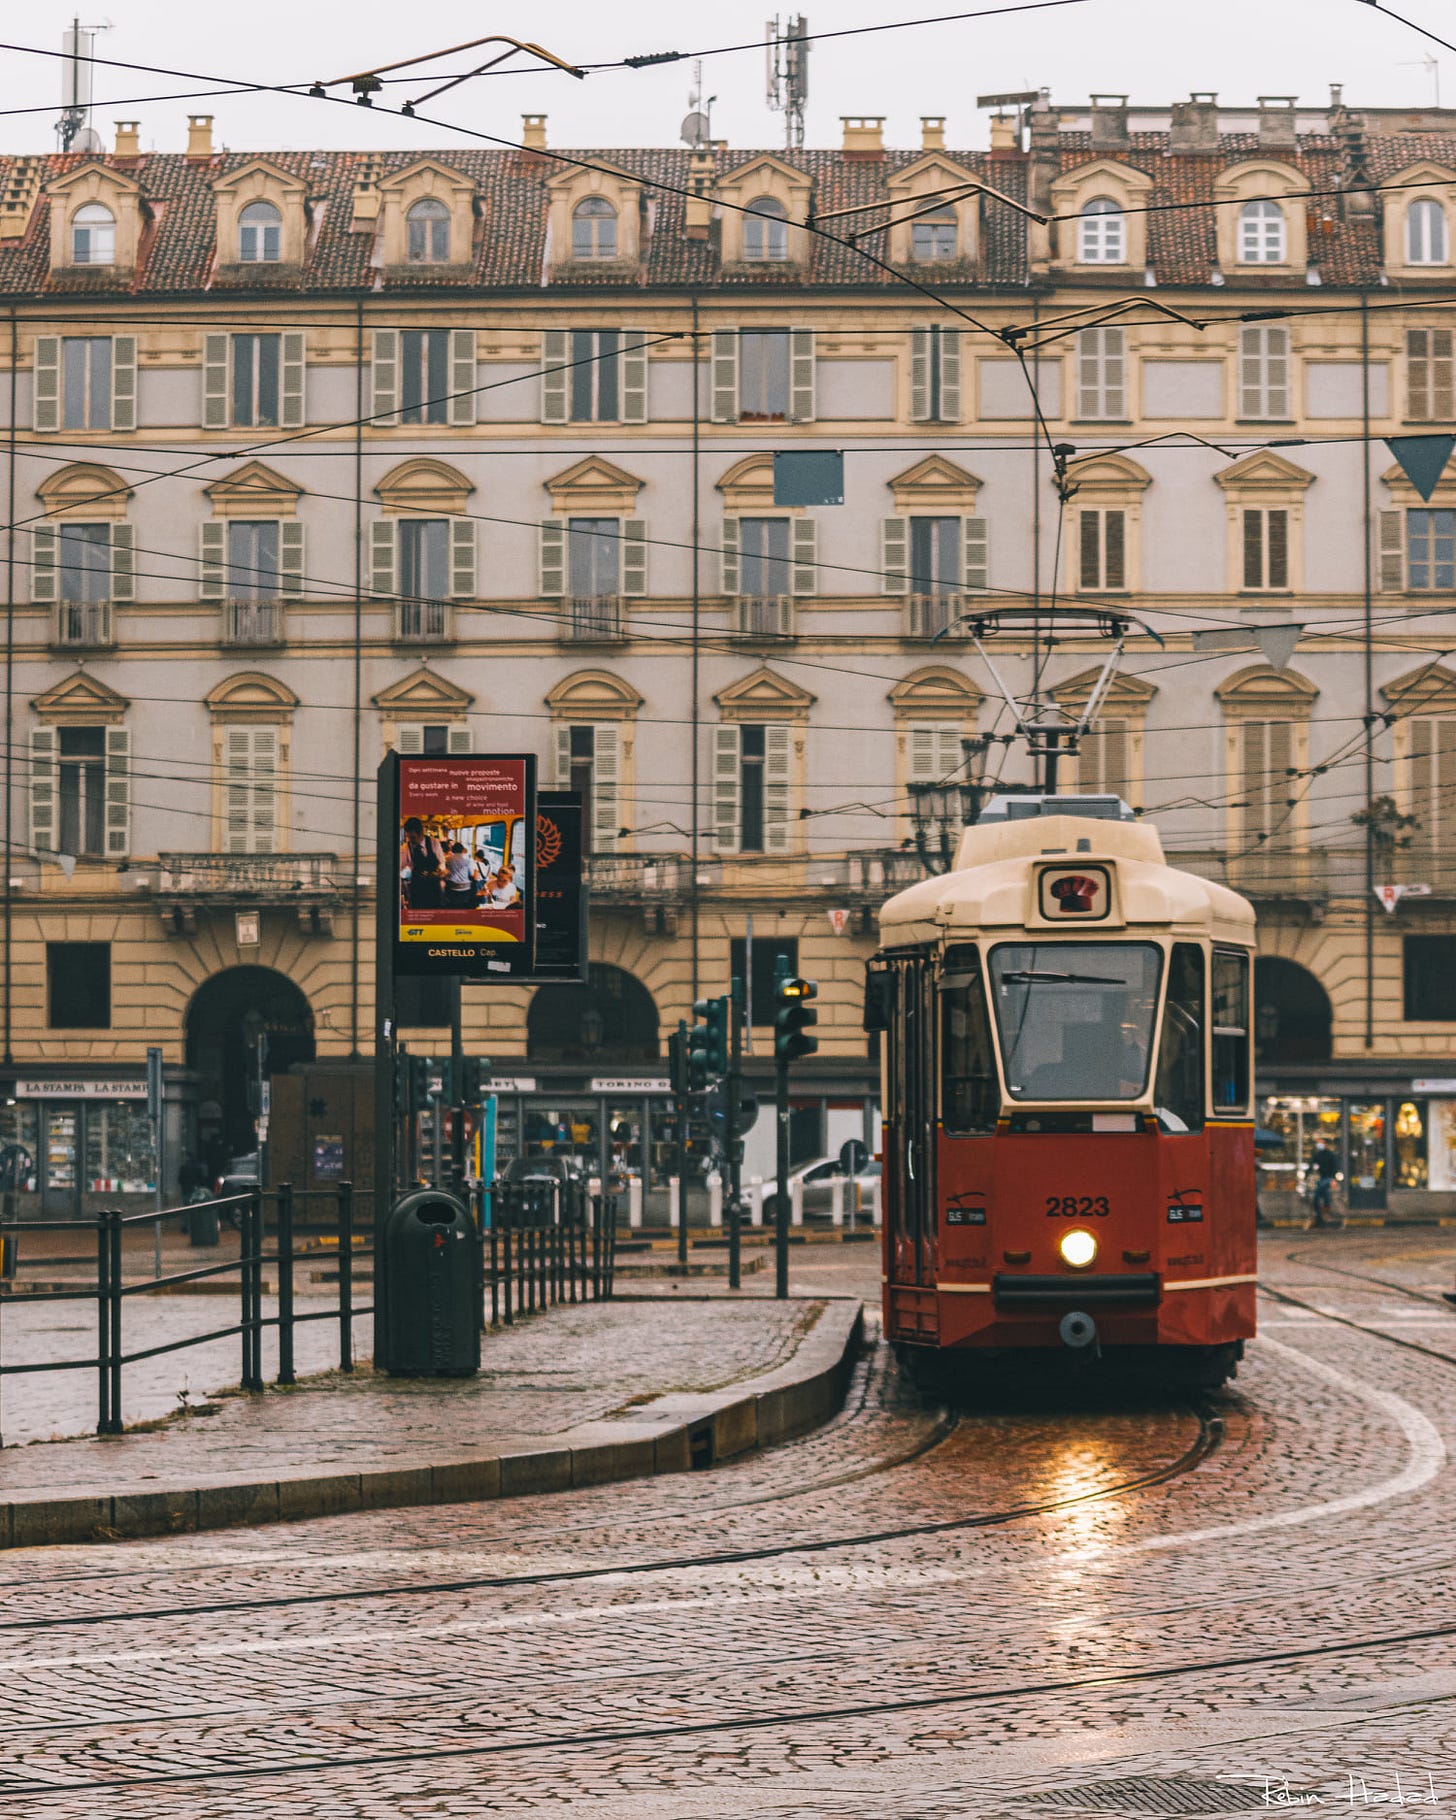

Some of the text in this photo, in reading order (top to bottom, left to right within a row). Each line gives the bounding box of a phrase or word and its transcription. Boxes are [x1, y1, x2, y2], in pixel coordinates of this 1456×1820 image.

[471, 769, 500, 777] proposte
[408, 782, 418, 790] da
[420, 782, 449, 791] gustare
[467, 782, 518, 791] movimento
[483, 807, 515, 815] motion
[428, 948, 475, 957] CASTELLO
[26, 1083, 40, 1092] LA
[43, 1083, 85, 1092] STAMPA
[95, 1083, 108, 1092] LA
[1046, 1196, 1109, 1217] 2823
